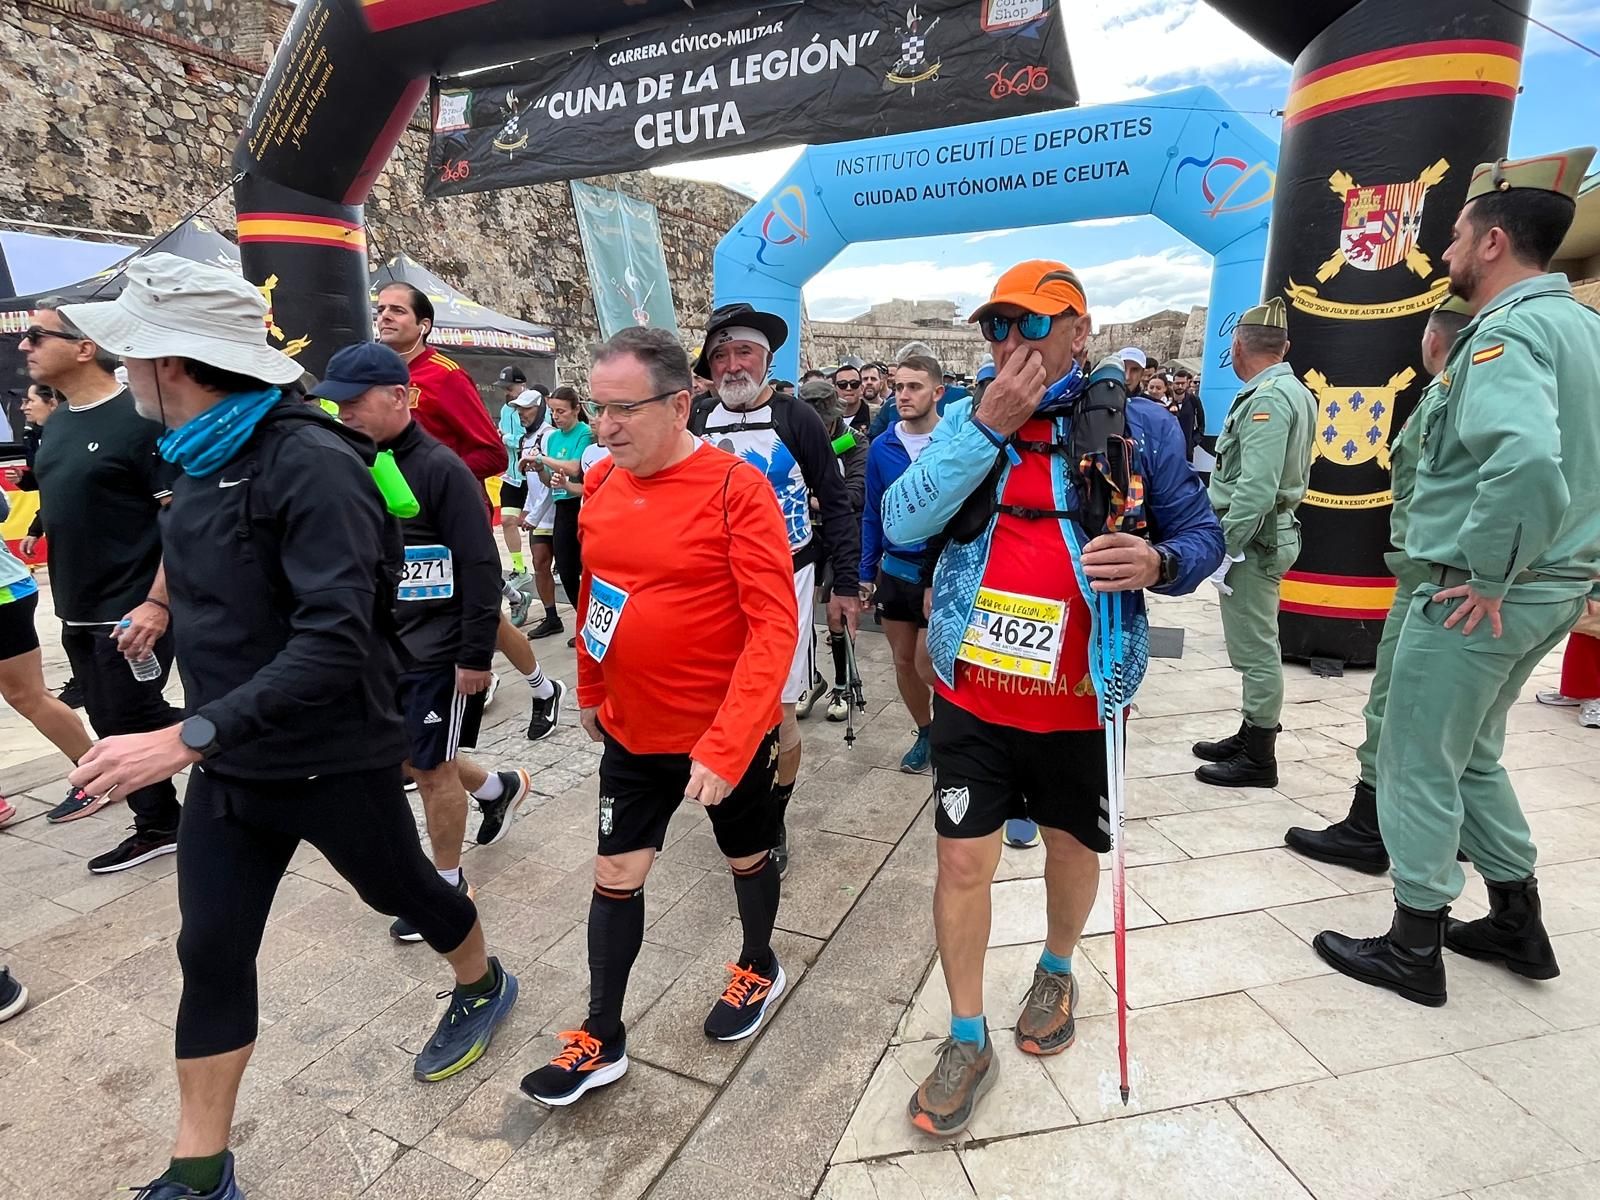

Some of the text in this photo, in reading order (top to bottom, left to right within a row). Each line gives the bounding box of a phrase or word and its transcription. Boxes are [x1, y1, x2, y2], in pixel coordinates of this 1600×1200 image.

[995, 7, 1028, 20] Shop
[609, 21, 783, 66] CARRERA CÍVICO-MILITAR
[534, 30, 879, 119] “CUNA DE LA LEGIÓN”
[280, 101, 299, 137] distancia
[293, 115, 307, 138] llegar
[635, 102, 746, 149] CEUTA
[836, 116, 1153, 176] INSTITUTO CEUTÍ DE DEPORTES
[854, 160, 1130, 207] CIUDAD AUTÓNOMA DE CEUTA
[1296, 296, 1314, 308] TERCIO
[1406, 303, 1415, 311] DE
[989, 616, 1054, 651] 4622
[976, 667, 1068, 696] AFRICANA
